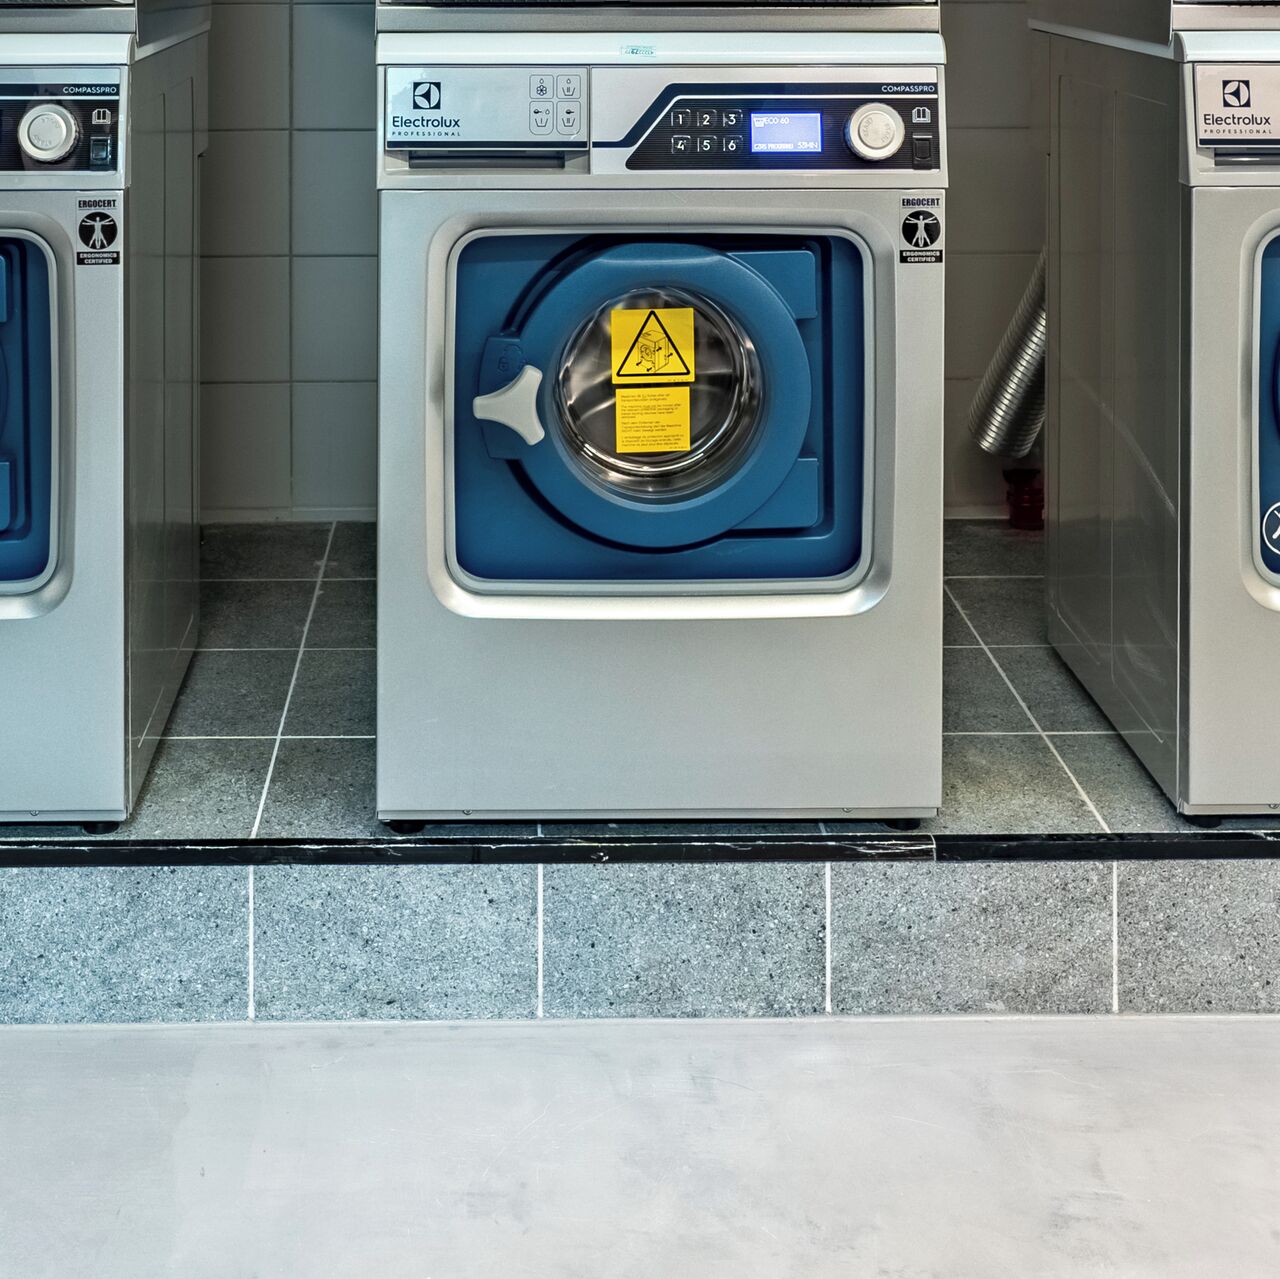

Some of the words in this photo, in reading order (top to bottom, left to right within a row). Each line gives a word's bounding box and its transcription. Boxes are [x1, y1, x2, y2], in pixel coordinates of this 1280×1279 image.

[392, 115, 461, 129] Electrolux
[678, 114, 682, 124] 1
[702, 114, 710, 125] 2
[728, 114, 736, 125] 3
[1203, 113, 1271, 127] Electrolux
[677, 140, 684, 150] 4
[702, 140, 710, 151] 5
[728, 140, 736, 151] 6
[78, 199, 117, 208] ERGOCERT
[902, 198, 940, 207] ERGOCERT
